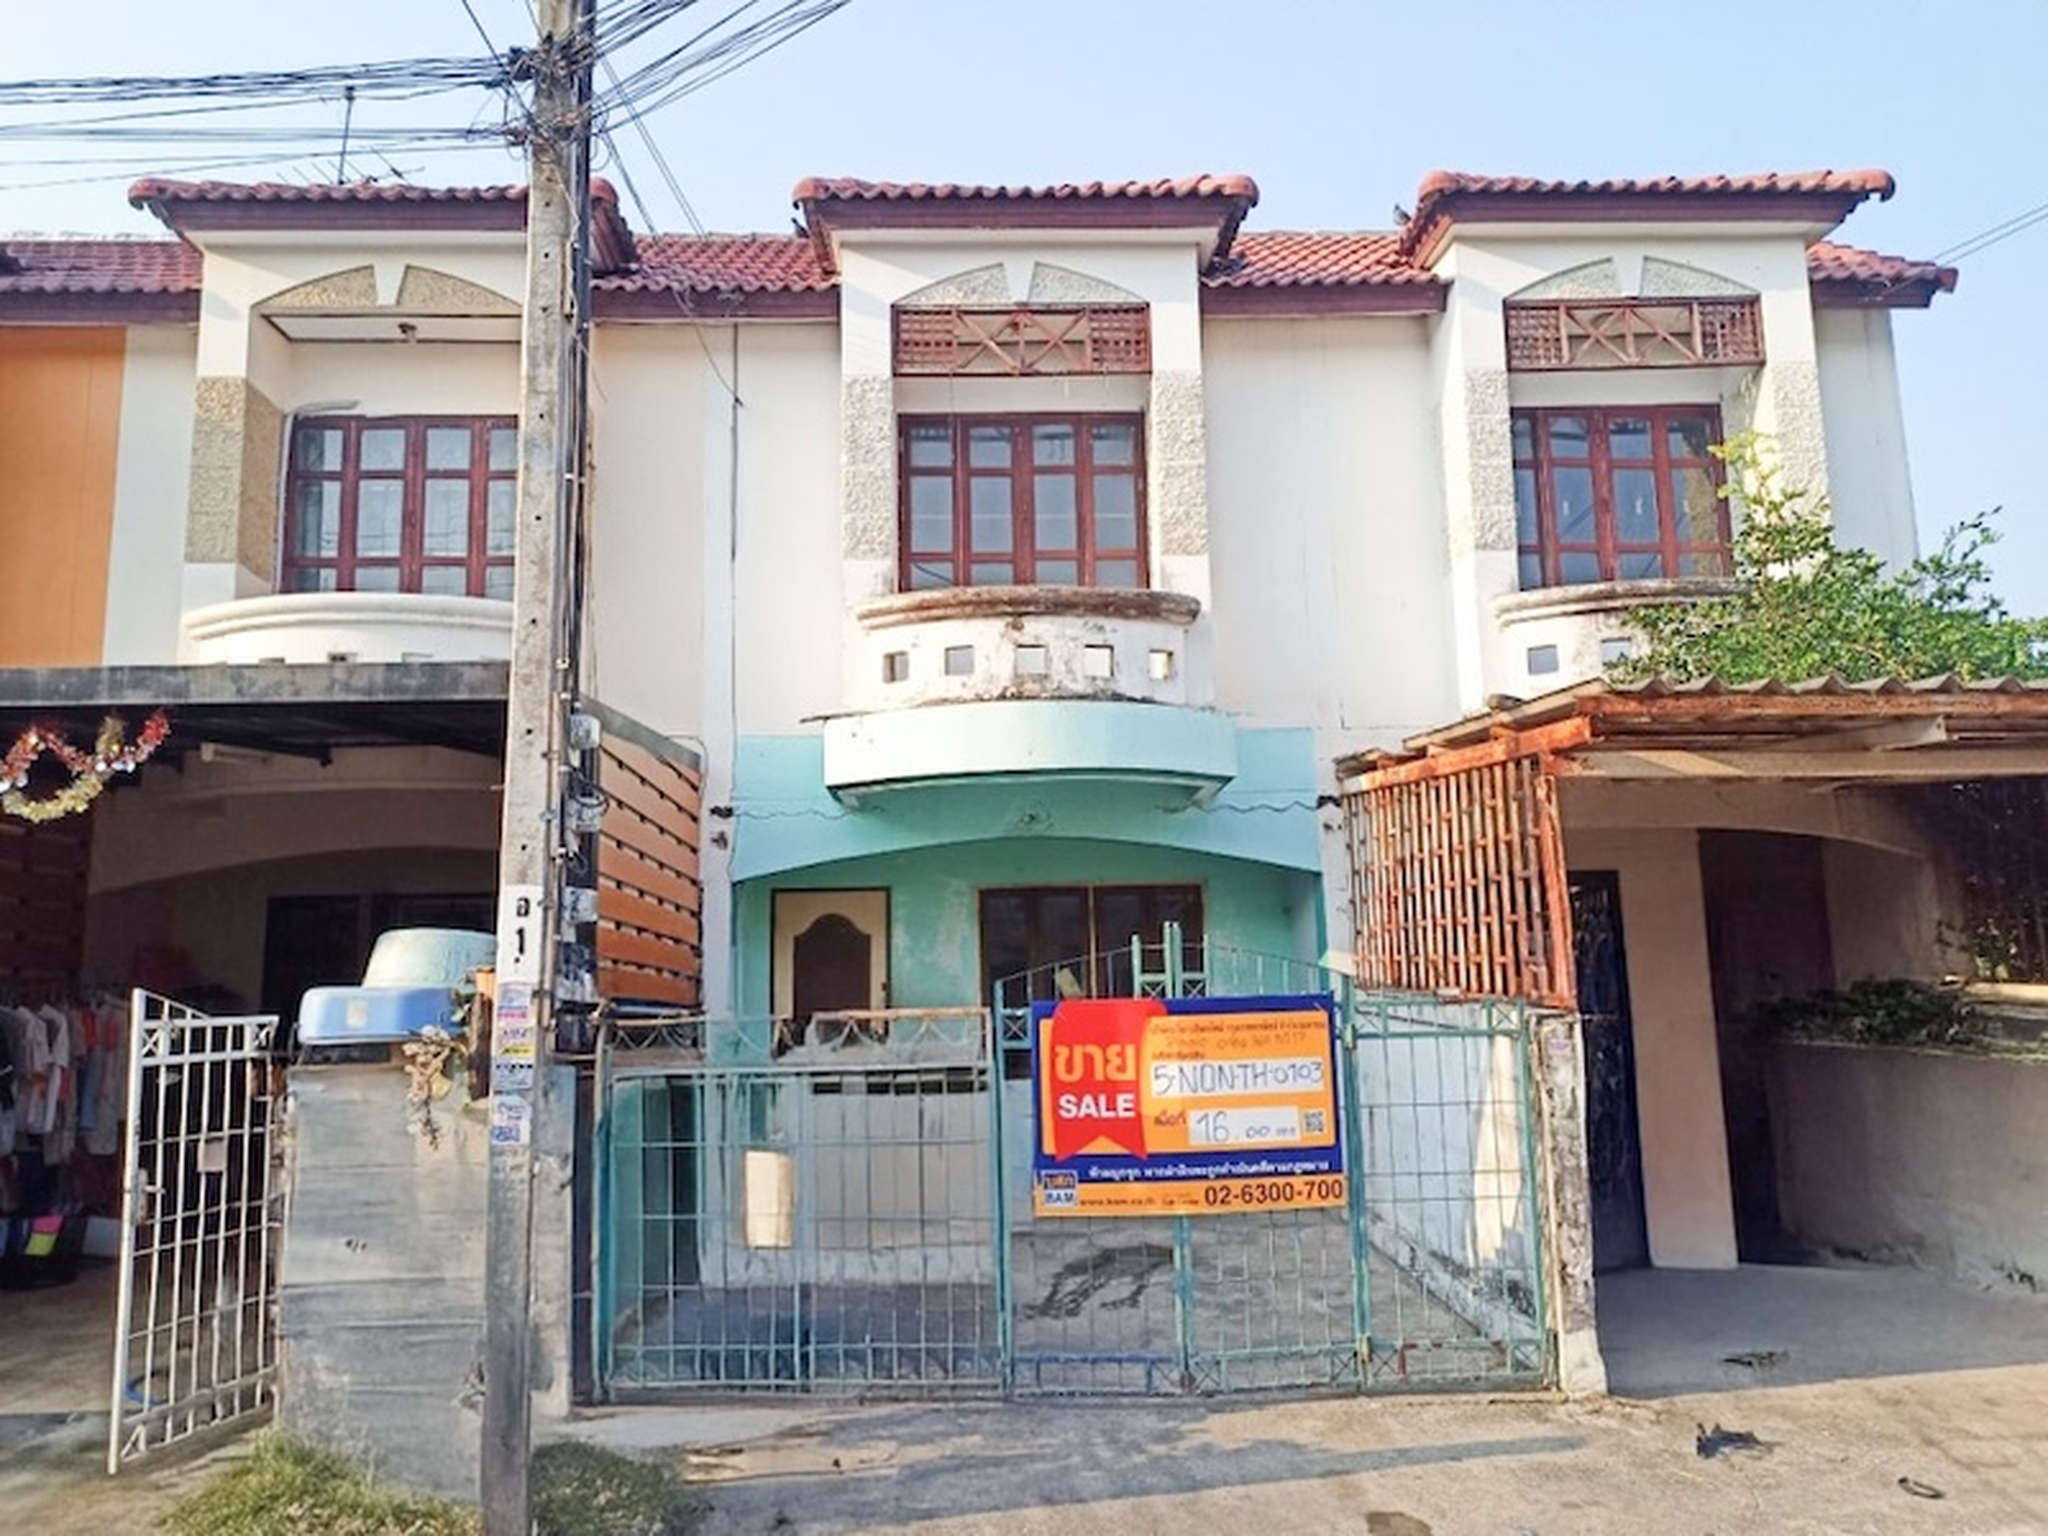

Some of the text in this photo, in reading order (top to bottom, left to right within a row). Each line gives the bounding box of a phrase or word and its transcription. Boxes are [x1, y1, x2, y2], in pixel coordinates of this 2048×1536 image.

[1054, 1043, 1137, 1083] ขาย
[1058, 1093, 1136, 1119] SALE
[1204, 1179, 1344, 1205] 02-6300-700
